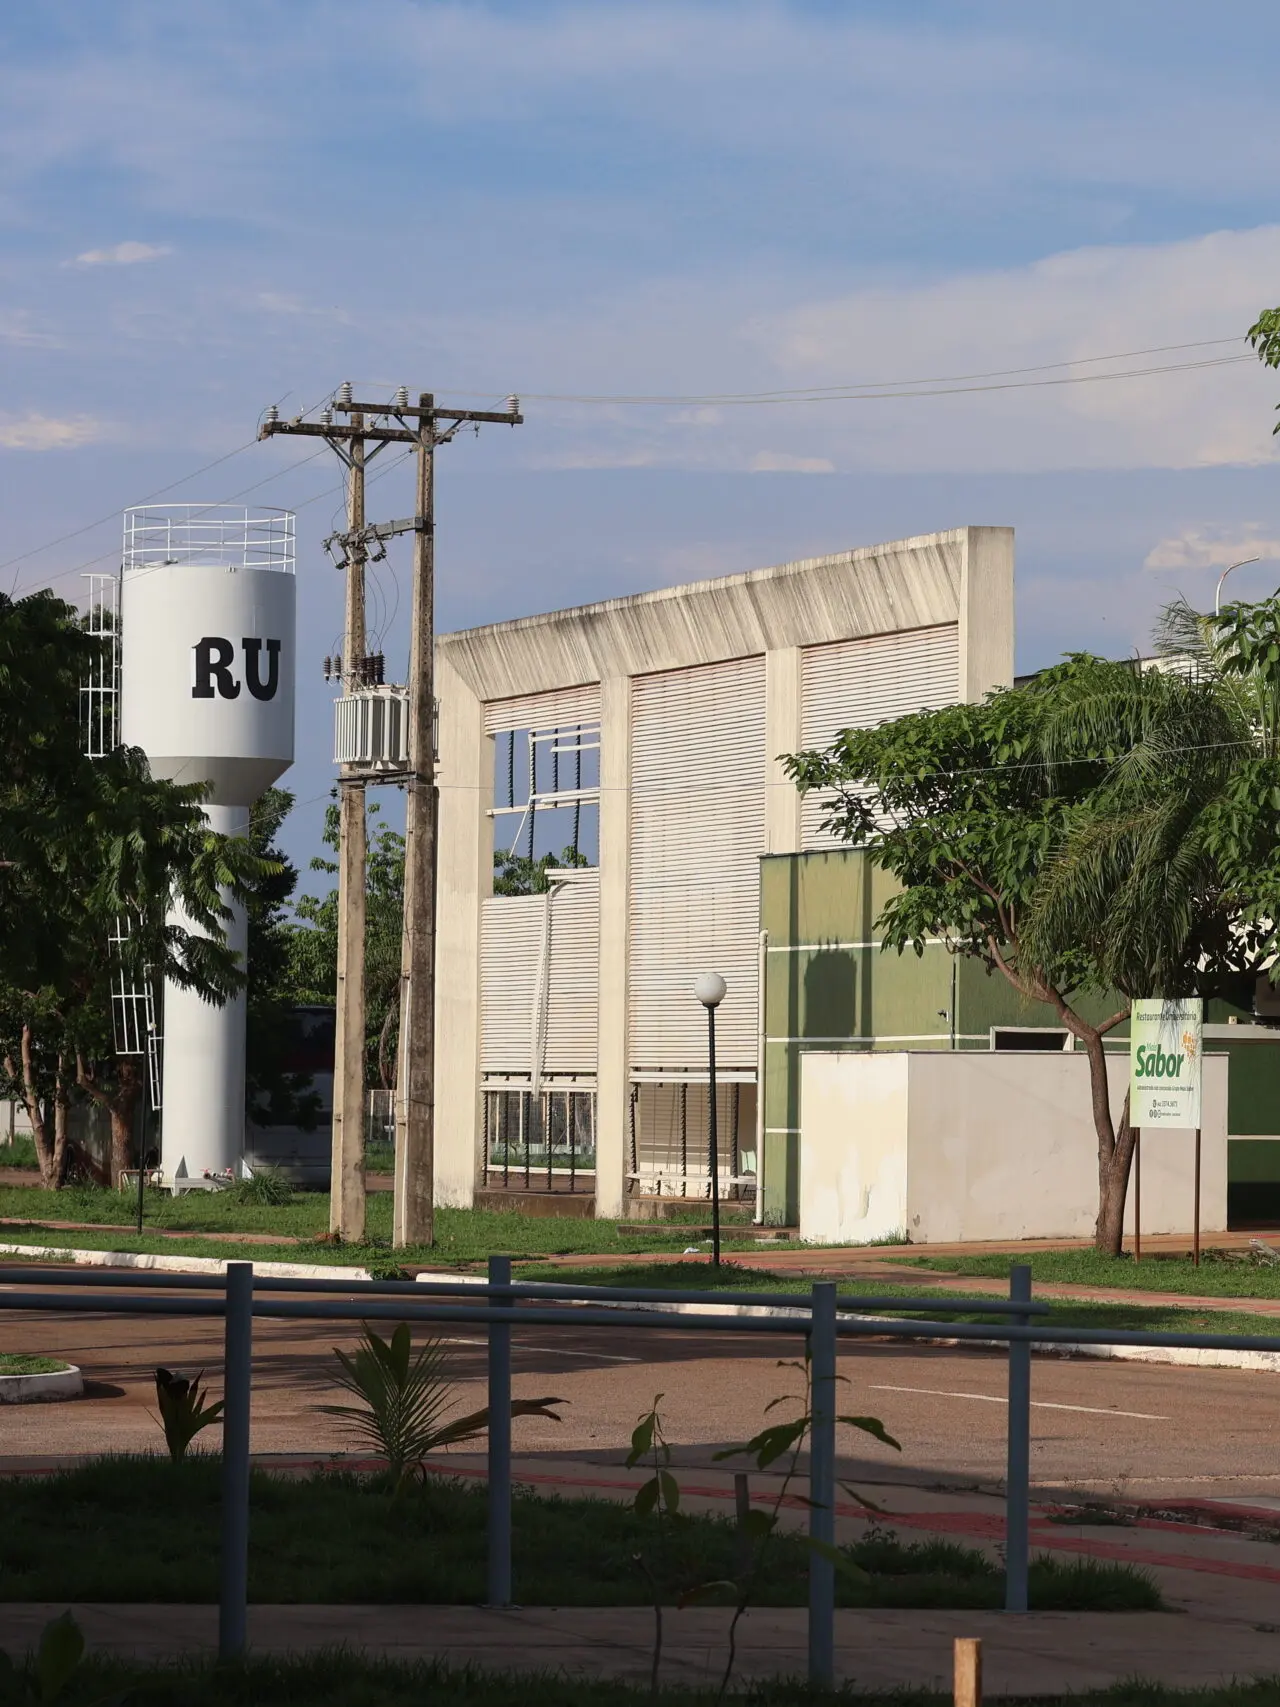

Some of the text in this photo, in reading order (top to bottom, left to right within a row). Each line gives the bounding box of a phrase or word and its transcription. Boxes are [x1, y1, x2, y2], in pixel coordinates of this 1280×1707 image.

[191, 636, 281, 701] RU
[1137, 1012, 1165, 1021] Restaurante
[1135, 1044, 1184, 1078] Sabor
